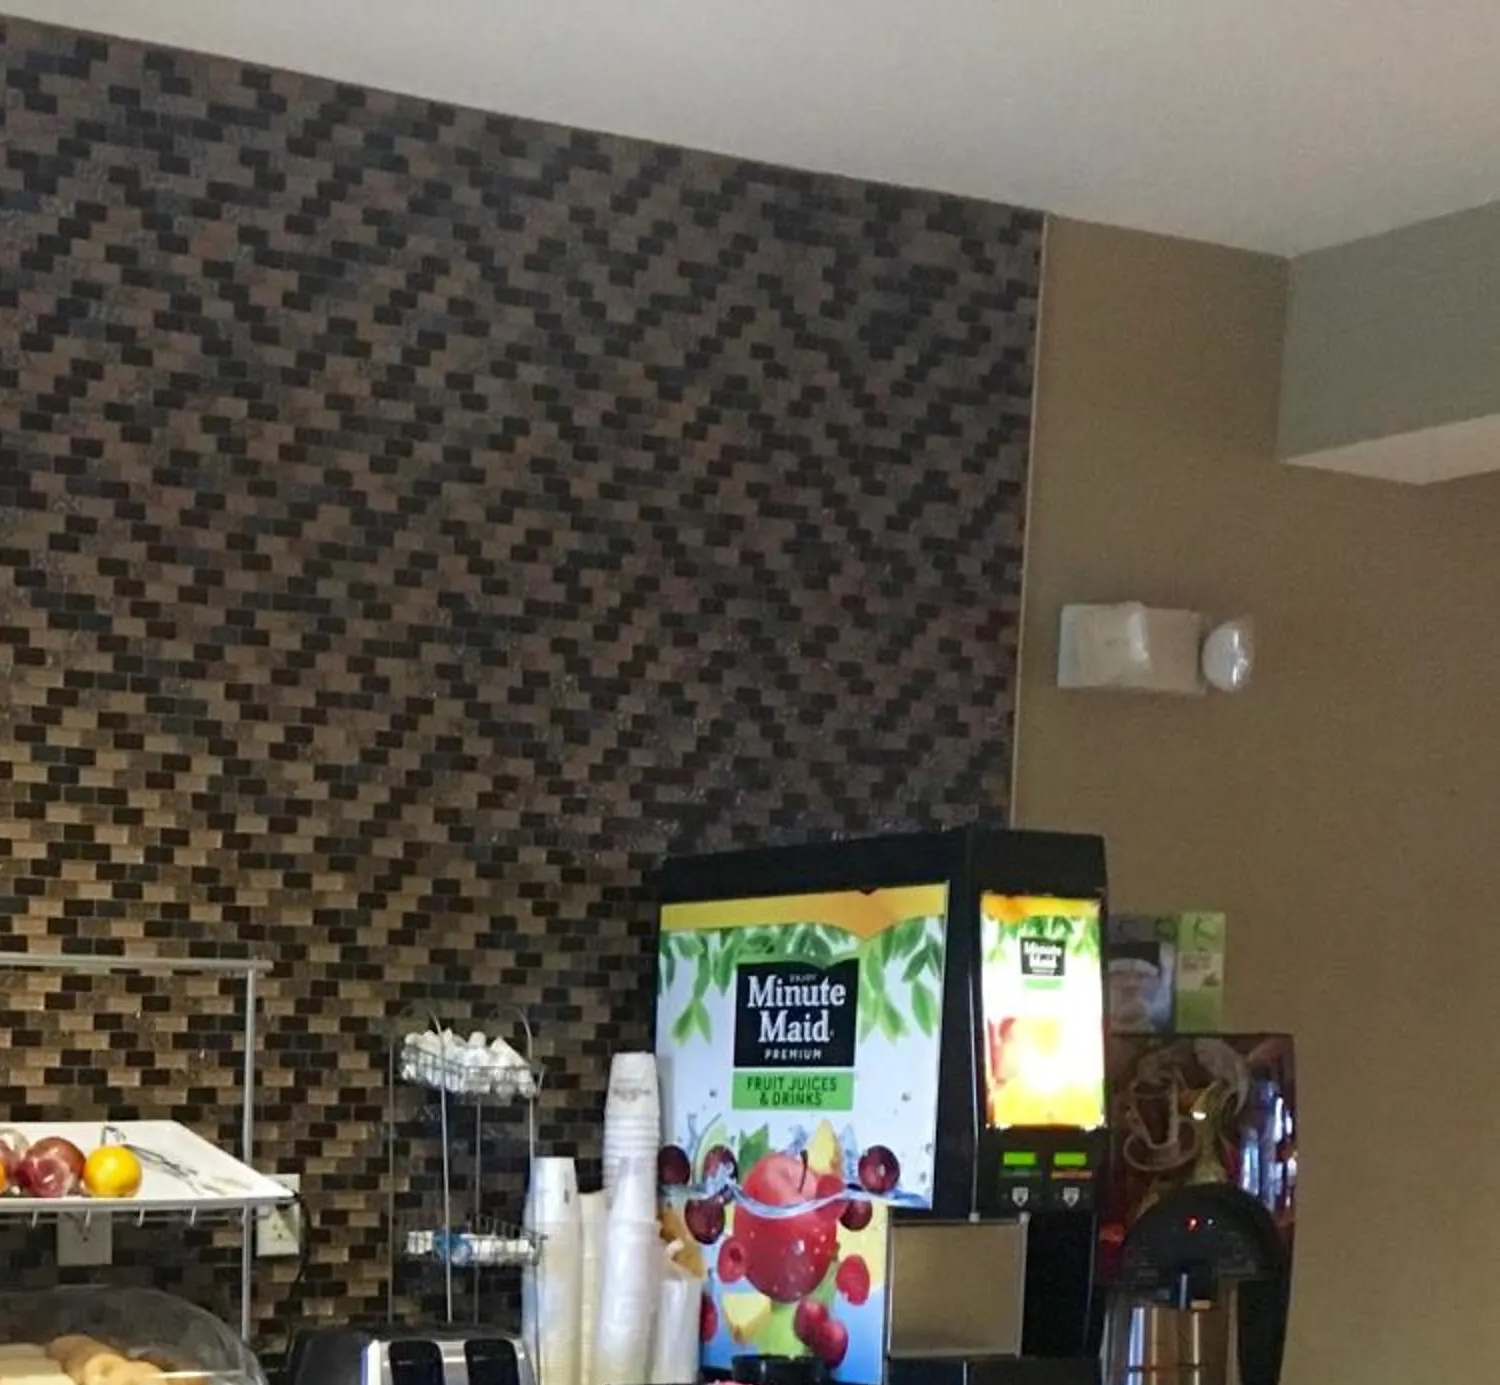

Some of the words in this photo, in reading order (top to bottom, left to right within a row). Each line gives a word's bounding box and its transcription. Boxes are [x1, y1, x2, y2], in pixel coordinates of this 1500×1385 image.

[747, 974, 846, 1008] Minute
[757, 1009, 831, 1043] Maid
[764, 1048, 822, 1060] PREMIUM
[746, 1075, 785, 1092] FRUIT
[788, 1075, 837, 1092] JUICES
[759, 1093, 769, 1106] &
[772, 1092, 822, 1106] DRINKS
